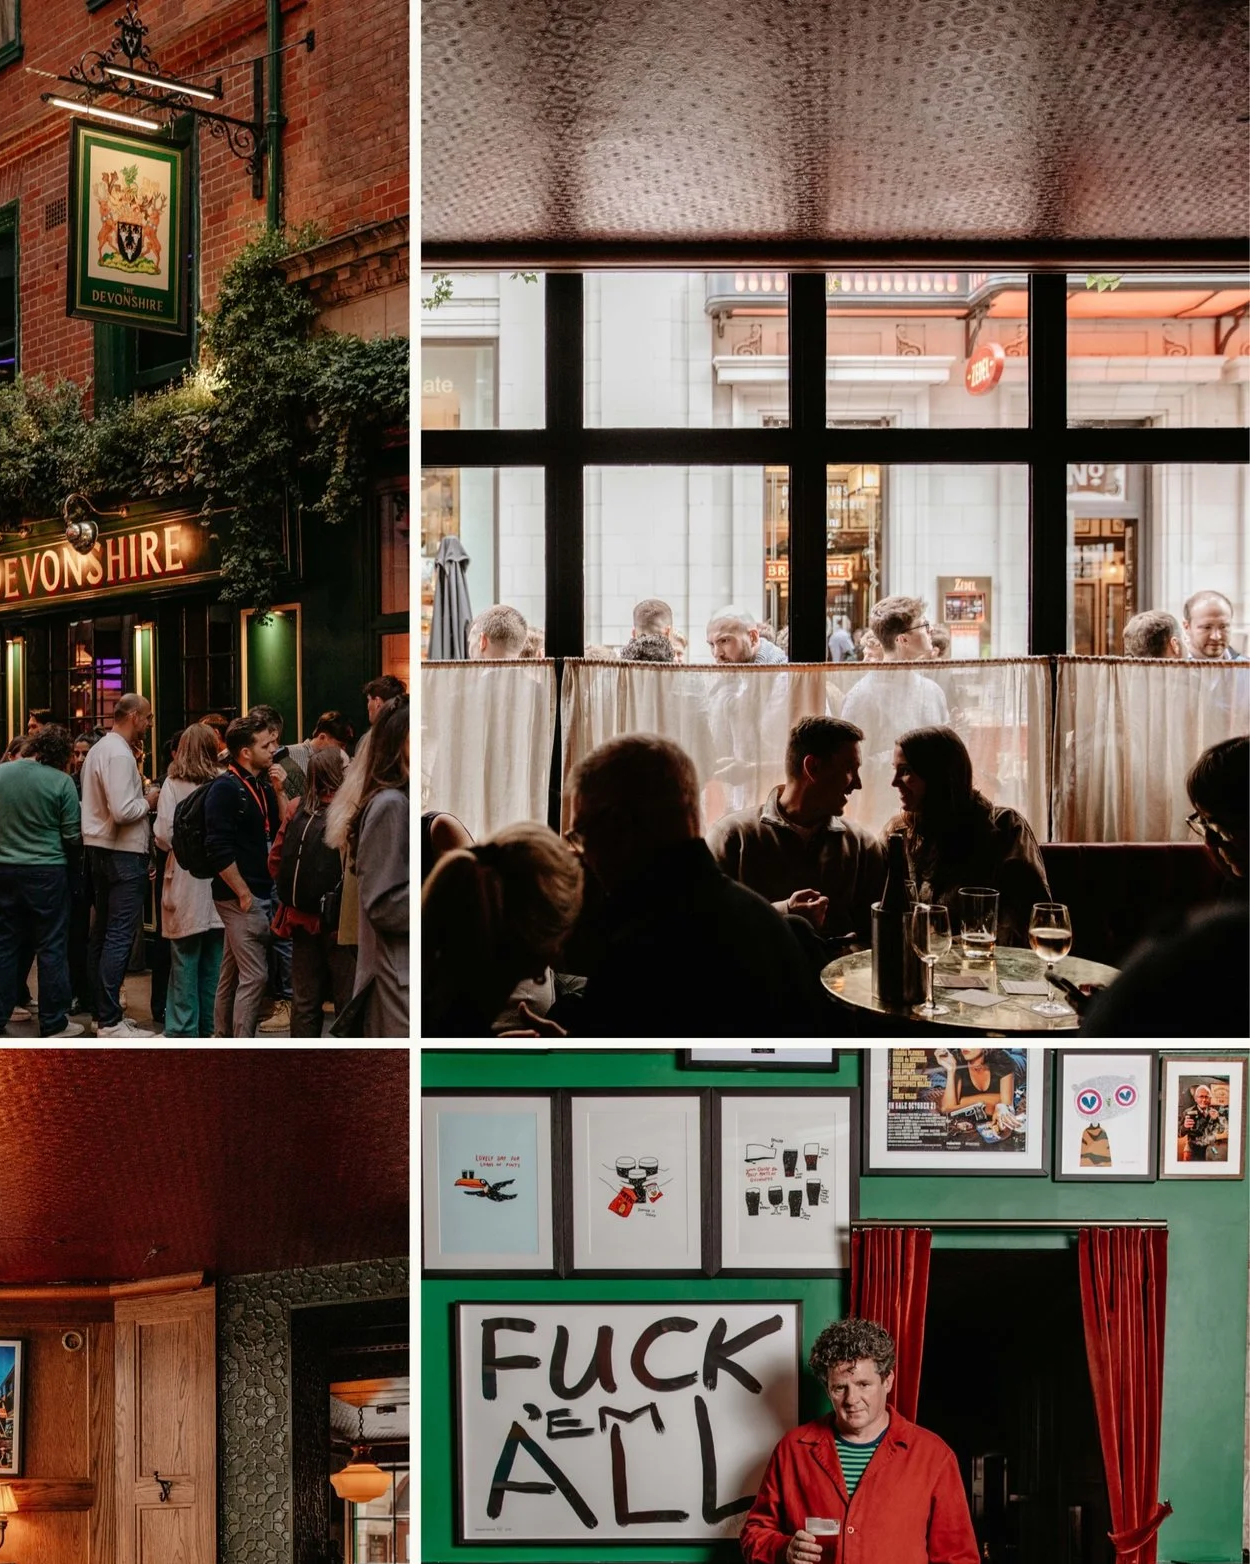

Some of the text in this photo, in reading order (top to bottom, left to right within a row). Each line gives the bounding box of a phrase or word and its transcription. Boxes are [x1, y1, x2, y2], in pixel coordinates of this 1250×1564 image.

[91, 289, 164, 313] DEVONSHIRE
[122, 286, 135, 295] THE
[481, 1314, 784, 1401] FUCK
[486, 1395, 758, 1530] ALL
